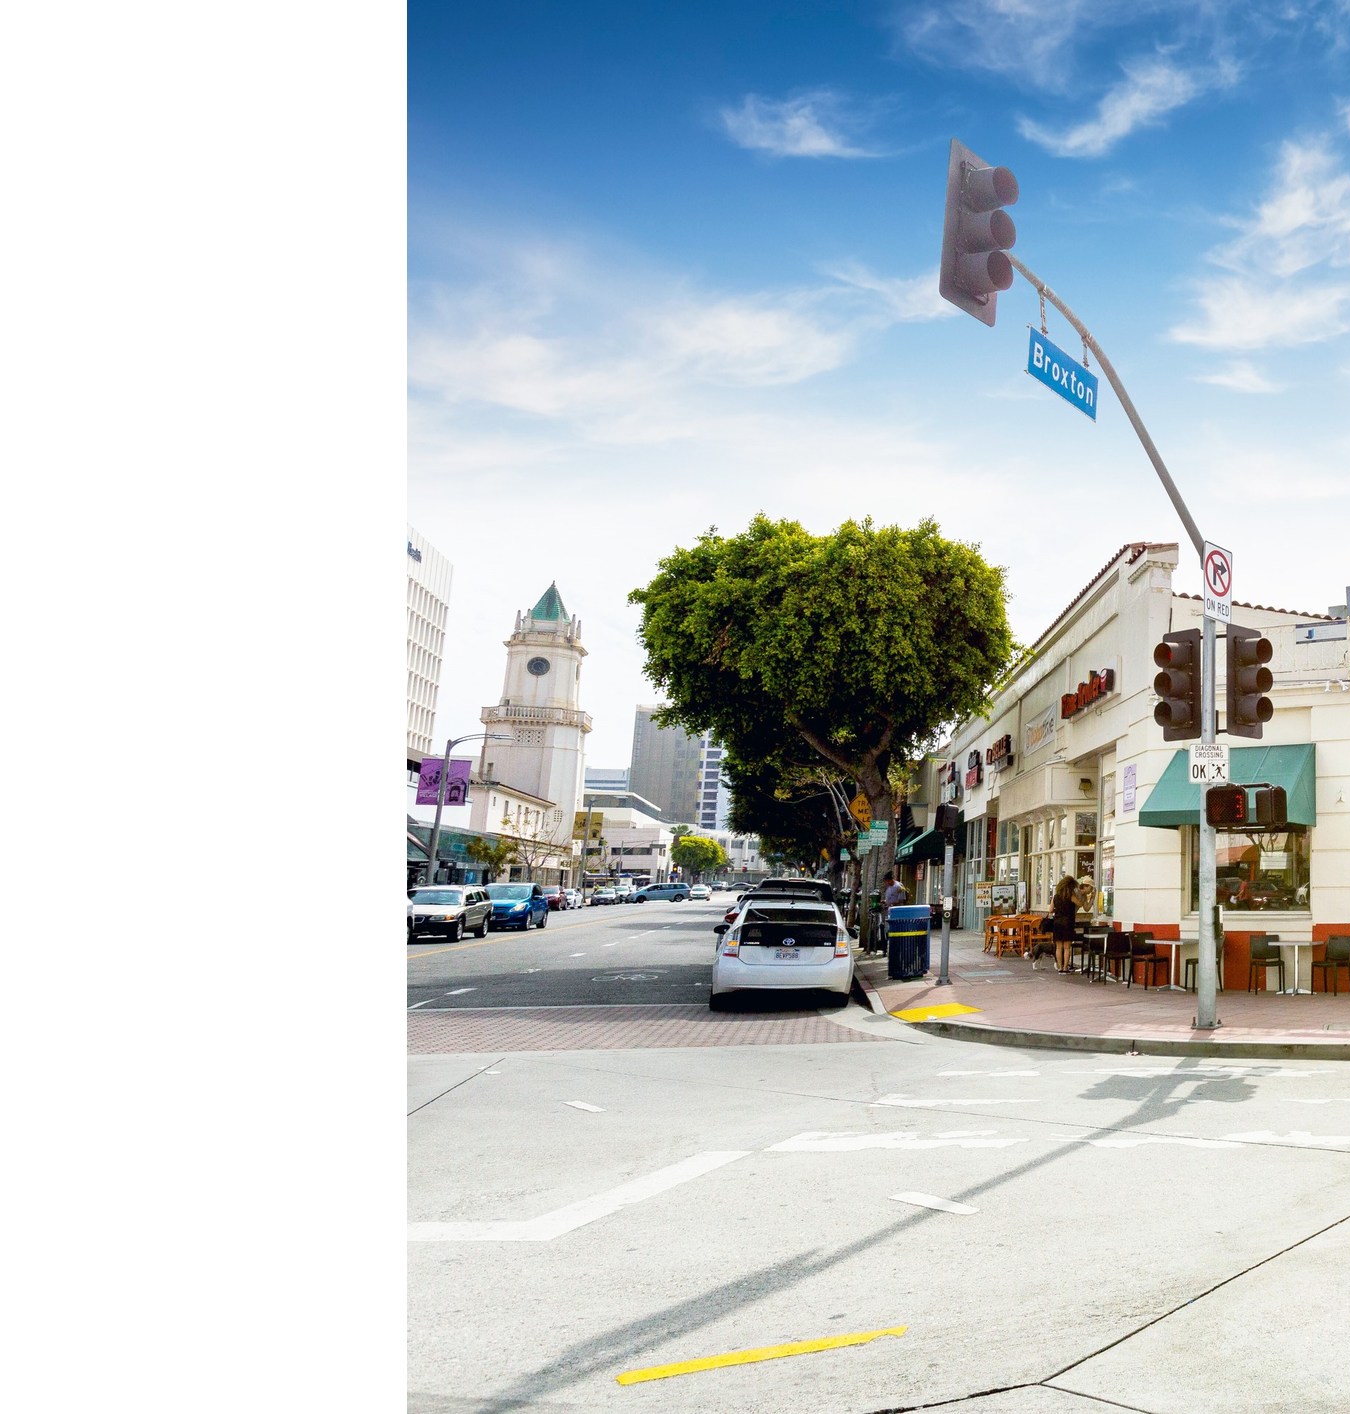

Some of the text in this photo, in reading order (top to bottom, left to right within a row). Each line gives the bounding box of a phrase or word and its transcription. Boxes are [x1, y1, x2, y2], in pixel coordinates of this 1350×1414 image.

[1033, 341, 1094, 407] Broxton
[1206, 598, 1230, 617] ON RED
[1192, 764, 1207, 779] OK
